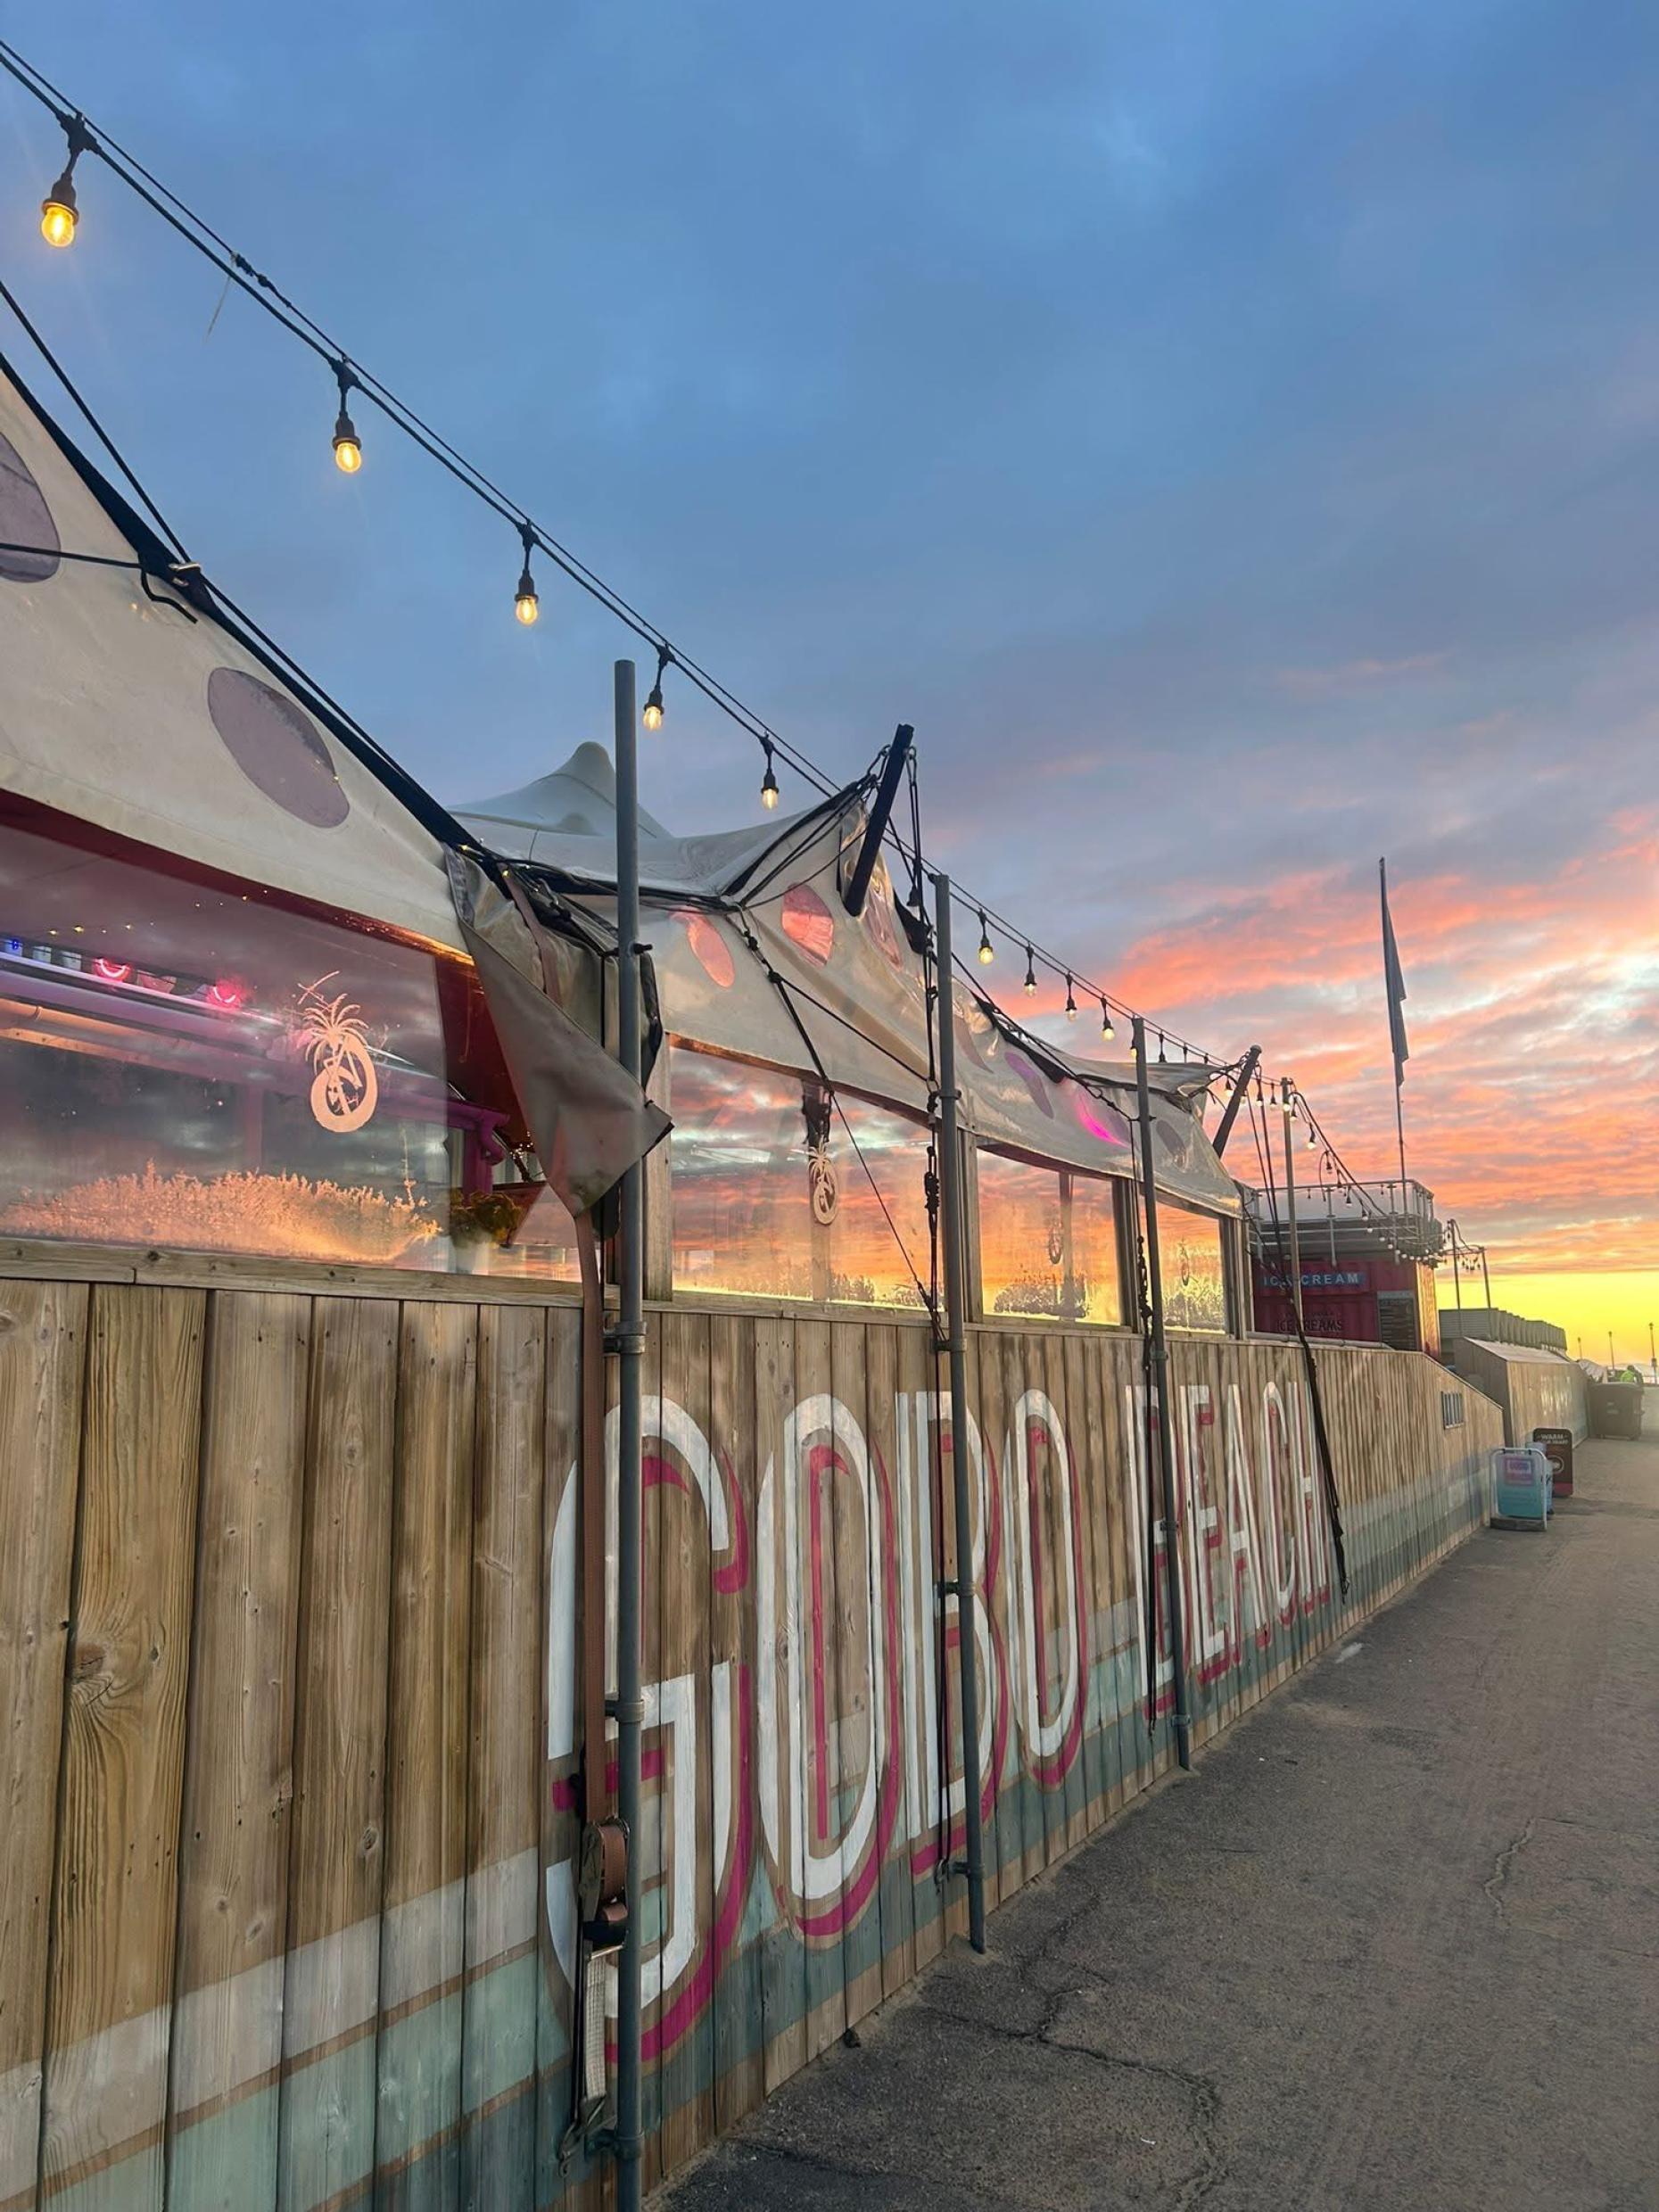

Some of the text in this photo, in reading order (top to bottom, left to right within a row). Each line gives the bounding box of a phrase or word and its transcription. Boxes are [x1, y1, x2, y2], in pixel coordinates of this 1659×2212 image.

[1300, 1273, 1358, 1285] CREAM
[546, 1381, 1330, 2064] GOBO BEACH
